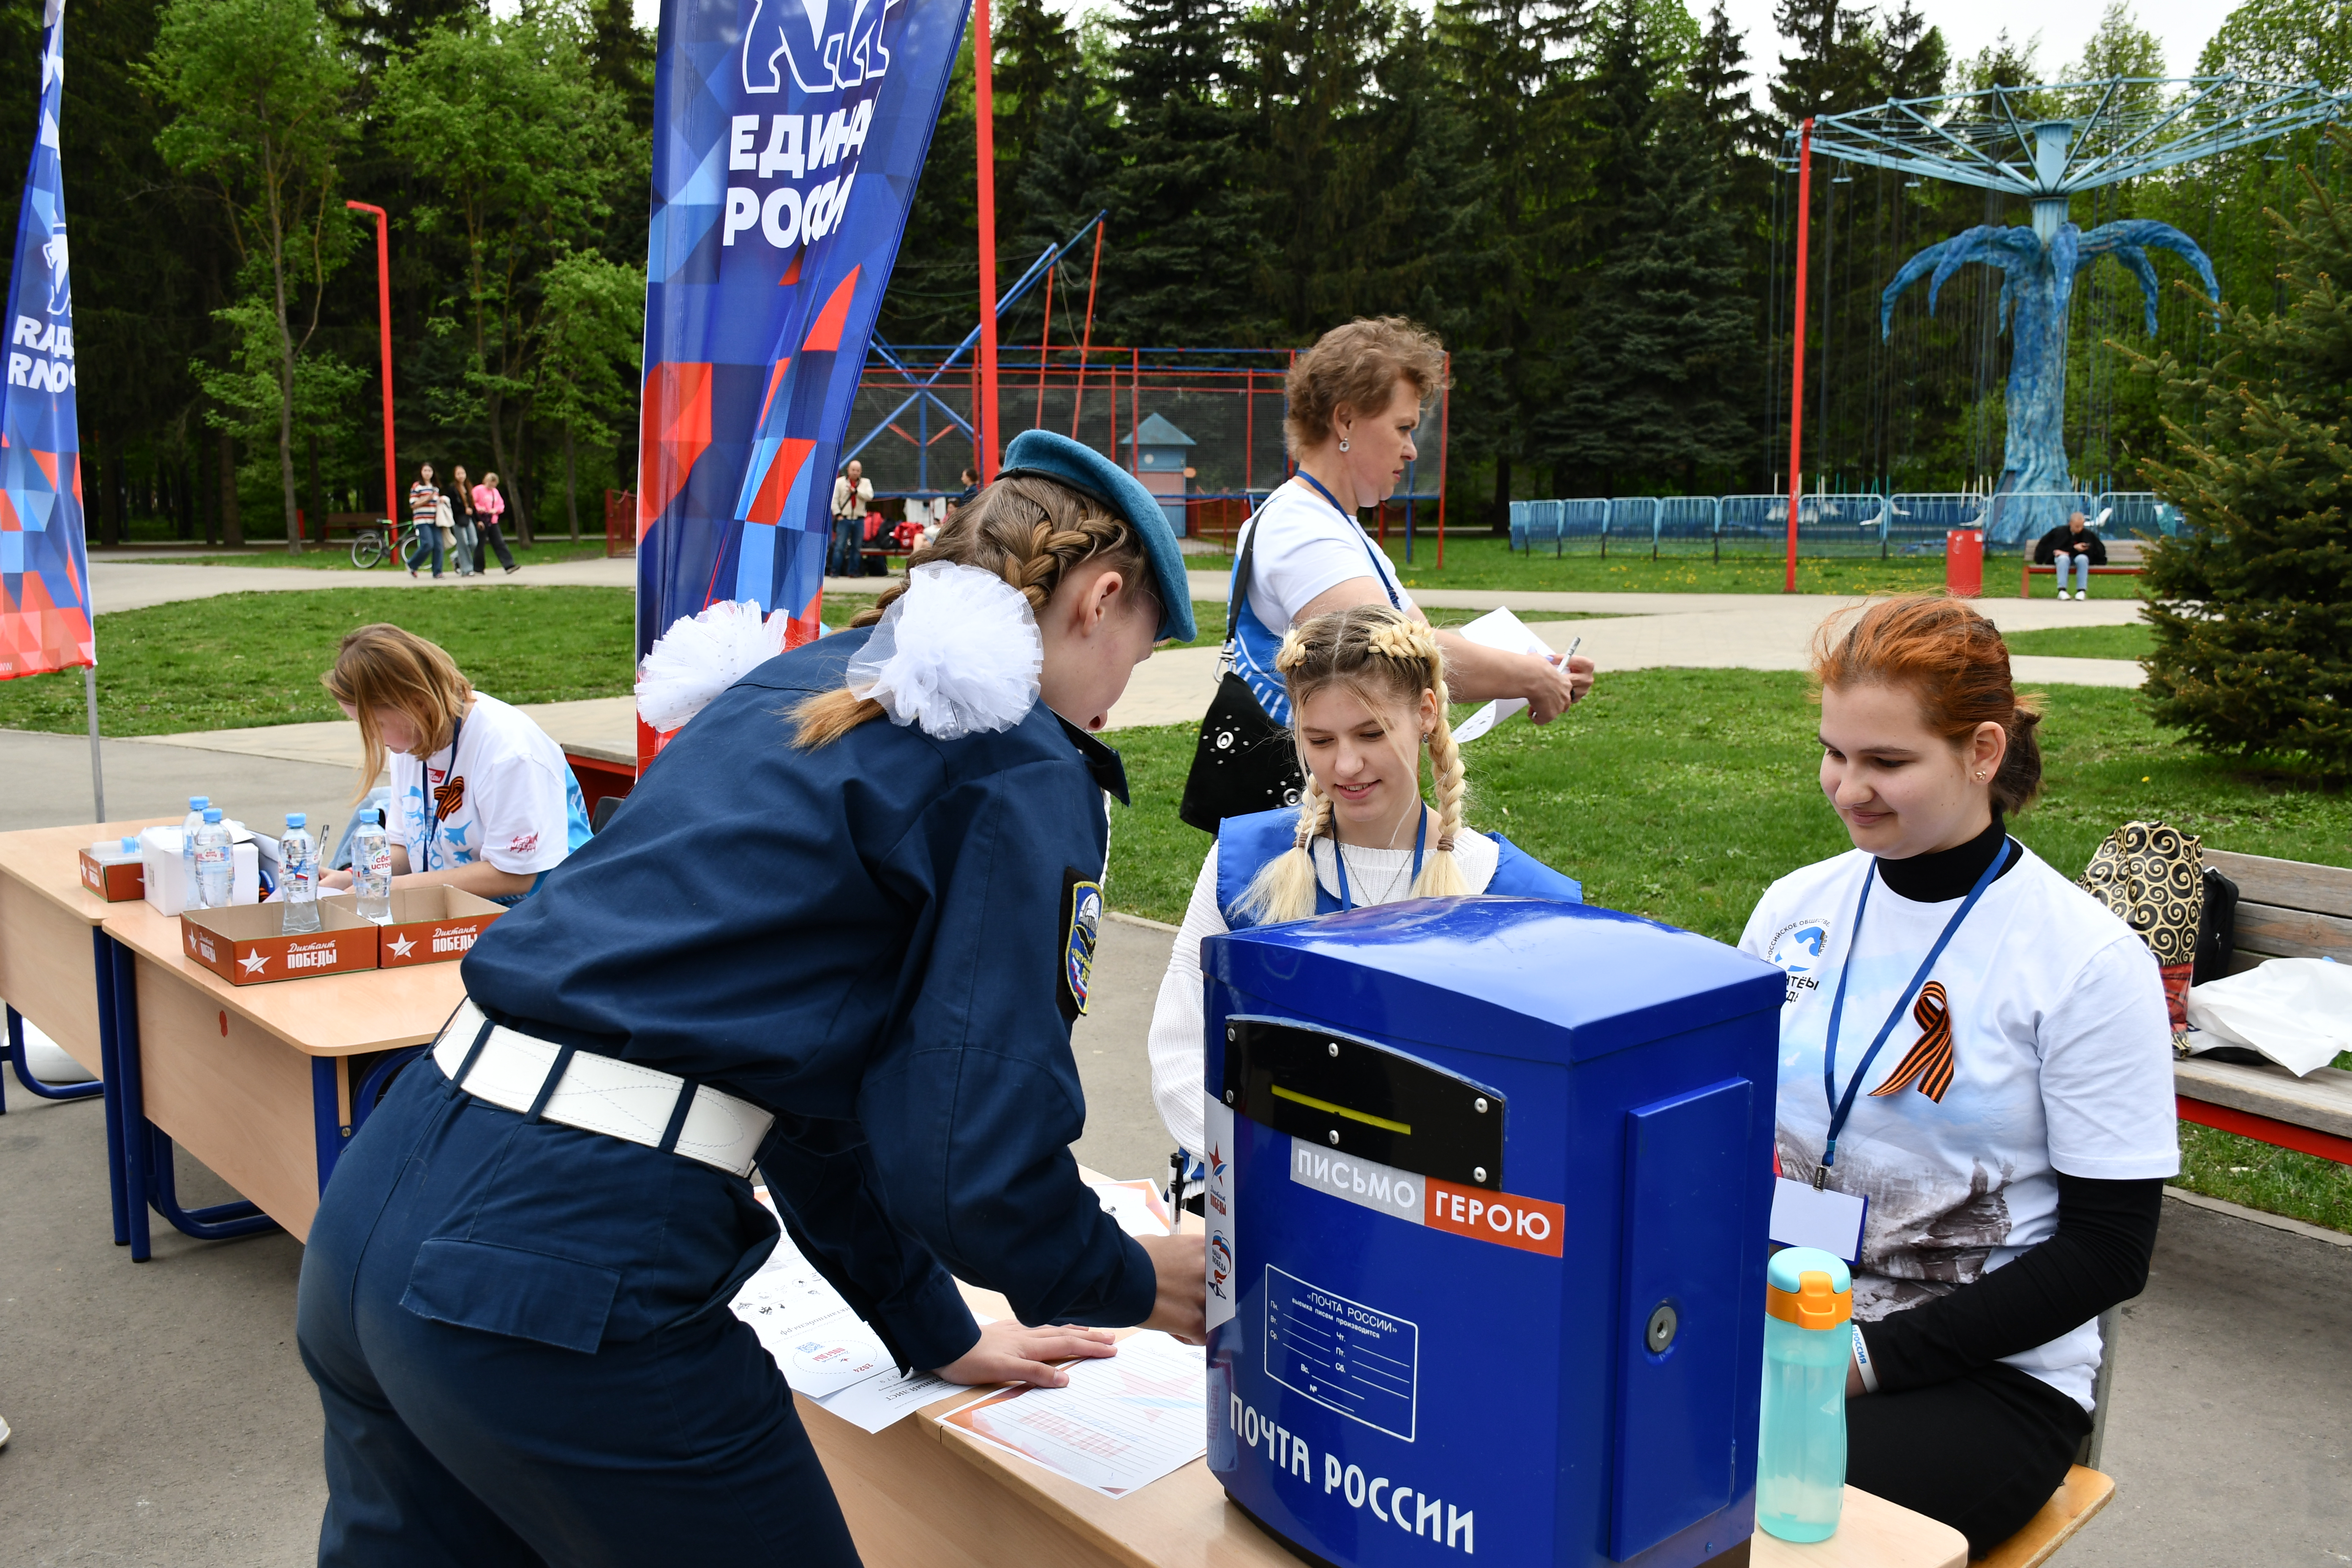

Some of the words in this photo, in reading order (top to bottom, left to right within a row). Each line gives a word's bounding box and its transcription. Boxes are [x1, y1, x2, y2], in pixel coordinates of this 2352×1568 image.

[730, 99, 873, 179] ЕДИНА
[723, 172, 855, 248] РОССИ
[1799, 918, 1830, 927] ОБЩЕСТВЕ
[433, 924, 477, 938] Диктант
[288, 939, 336, 953] Диктант
[287, 949, 337, 969] ПОБЕДЫ
[1298, 1149, 1415, 1208] ПИСЬМО
[1436, 1191, 1551, 1240] ГЕРОЮ
[1210, 1193, 1226, 1217] ПОБЕДЫ
[1212, 1247, 1222, 1261] НАША
[1212, 1255, 1227, 1273] ПОБЕДА
[1270, 1300, 1279, 1311] Пн.
[1307, 1292, 1343, 1314] «ПОЧТА
[1348, 1307, 1397, 1333] РОССИИ»
[1292, 1297, 1312, 1312] выемка
[1315, 1308, 1333, 1320] писем
[1336, 1316, 1380, 1339] производится
[1270, 1329, 1278, 1341] Ср.
[1336, 1331, 1346, 1342] Чт.
[812, 1347, 846, 1362] ПОБЕДЫ
[1335, 1346, 1345, 1358] Пт.
[1853, 1333, 1867, 1364] РОССИЯ
[853, 1363, 874, 1373] 2024
[1301, 1363, 1309, 1374] Вс.
[1335, 1362, 1346, 1373] Сб.
[1309, 1384, 1318, 1393] №
[1230, 1392, 1310, 1483] ПОЧТА
[1325, 1453, 1473, 1554] РОССИИ
